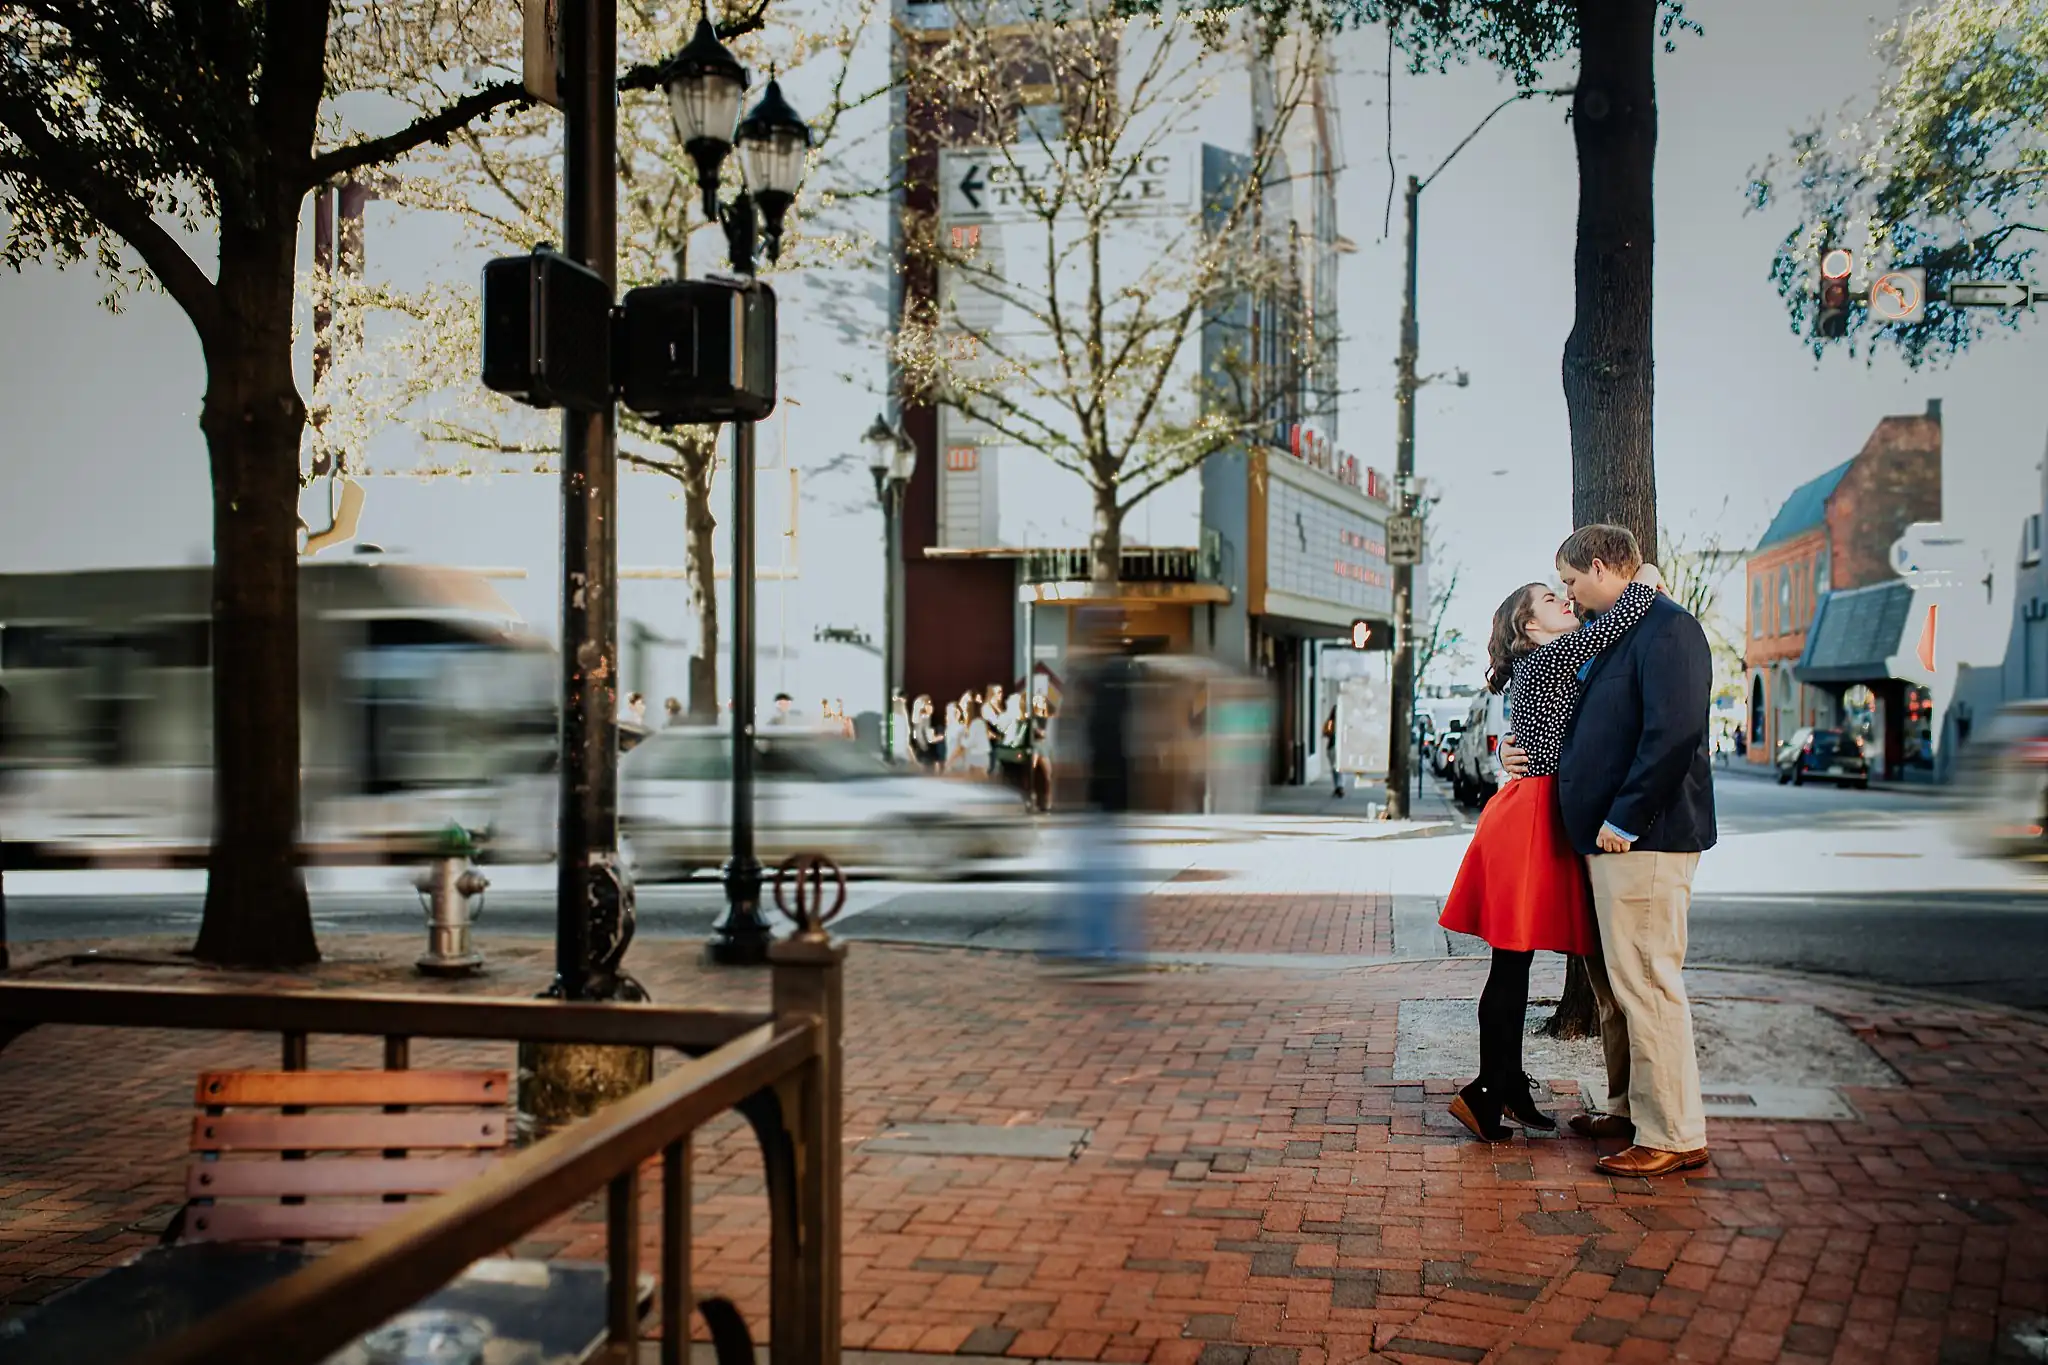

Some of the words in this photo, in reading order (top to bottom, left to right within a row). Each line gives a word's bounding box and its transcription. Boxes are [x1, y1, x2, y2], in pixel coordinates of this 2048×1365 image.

[987, 156, 1170, 183] CLASIC
[991, 180, 1166, 206] TLE
[1391, 519, 1419, 532] ONE
[1391, 534, 1418, 545] WAY
